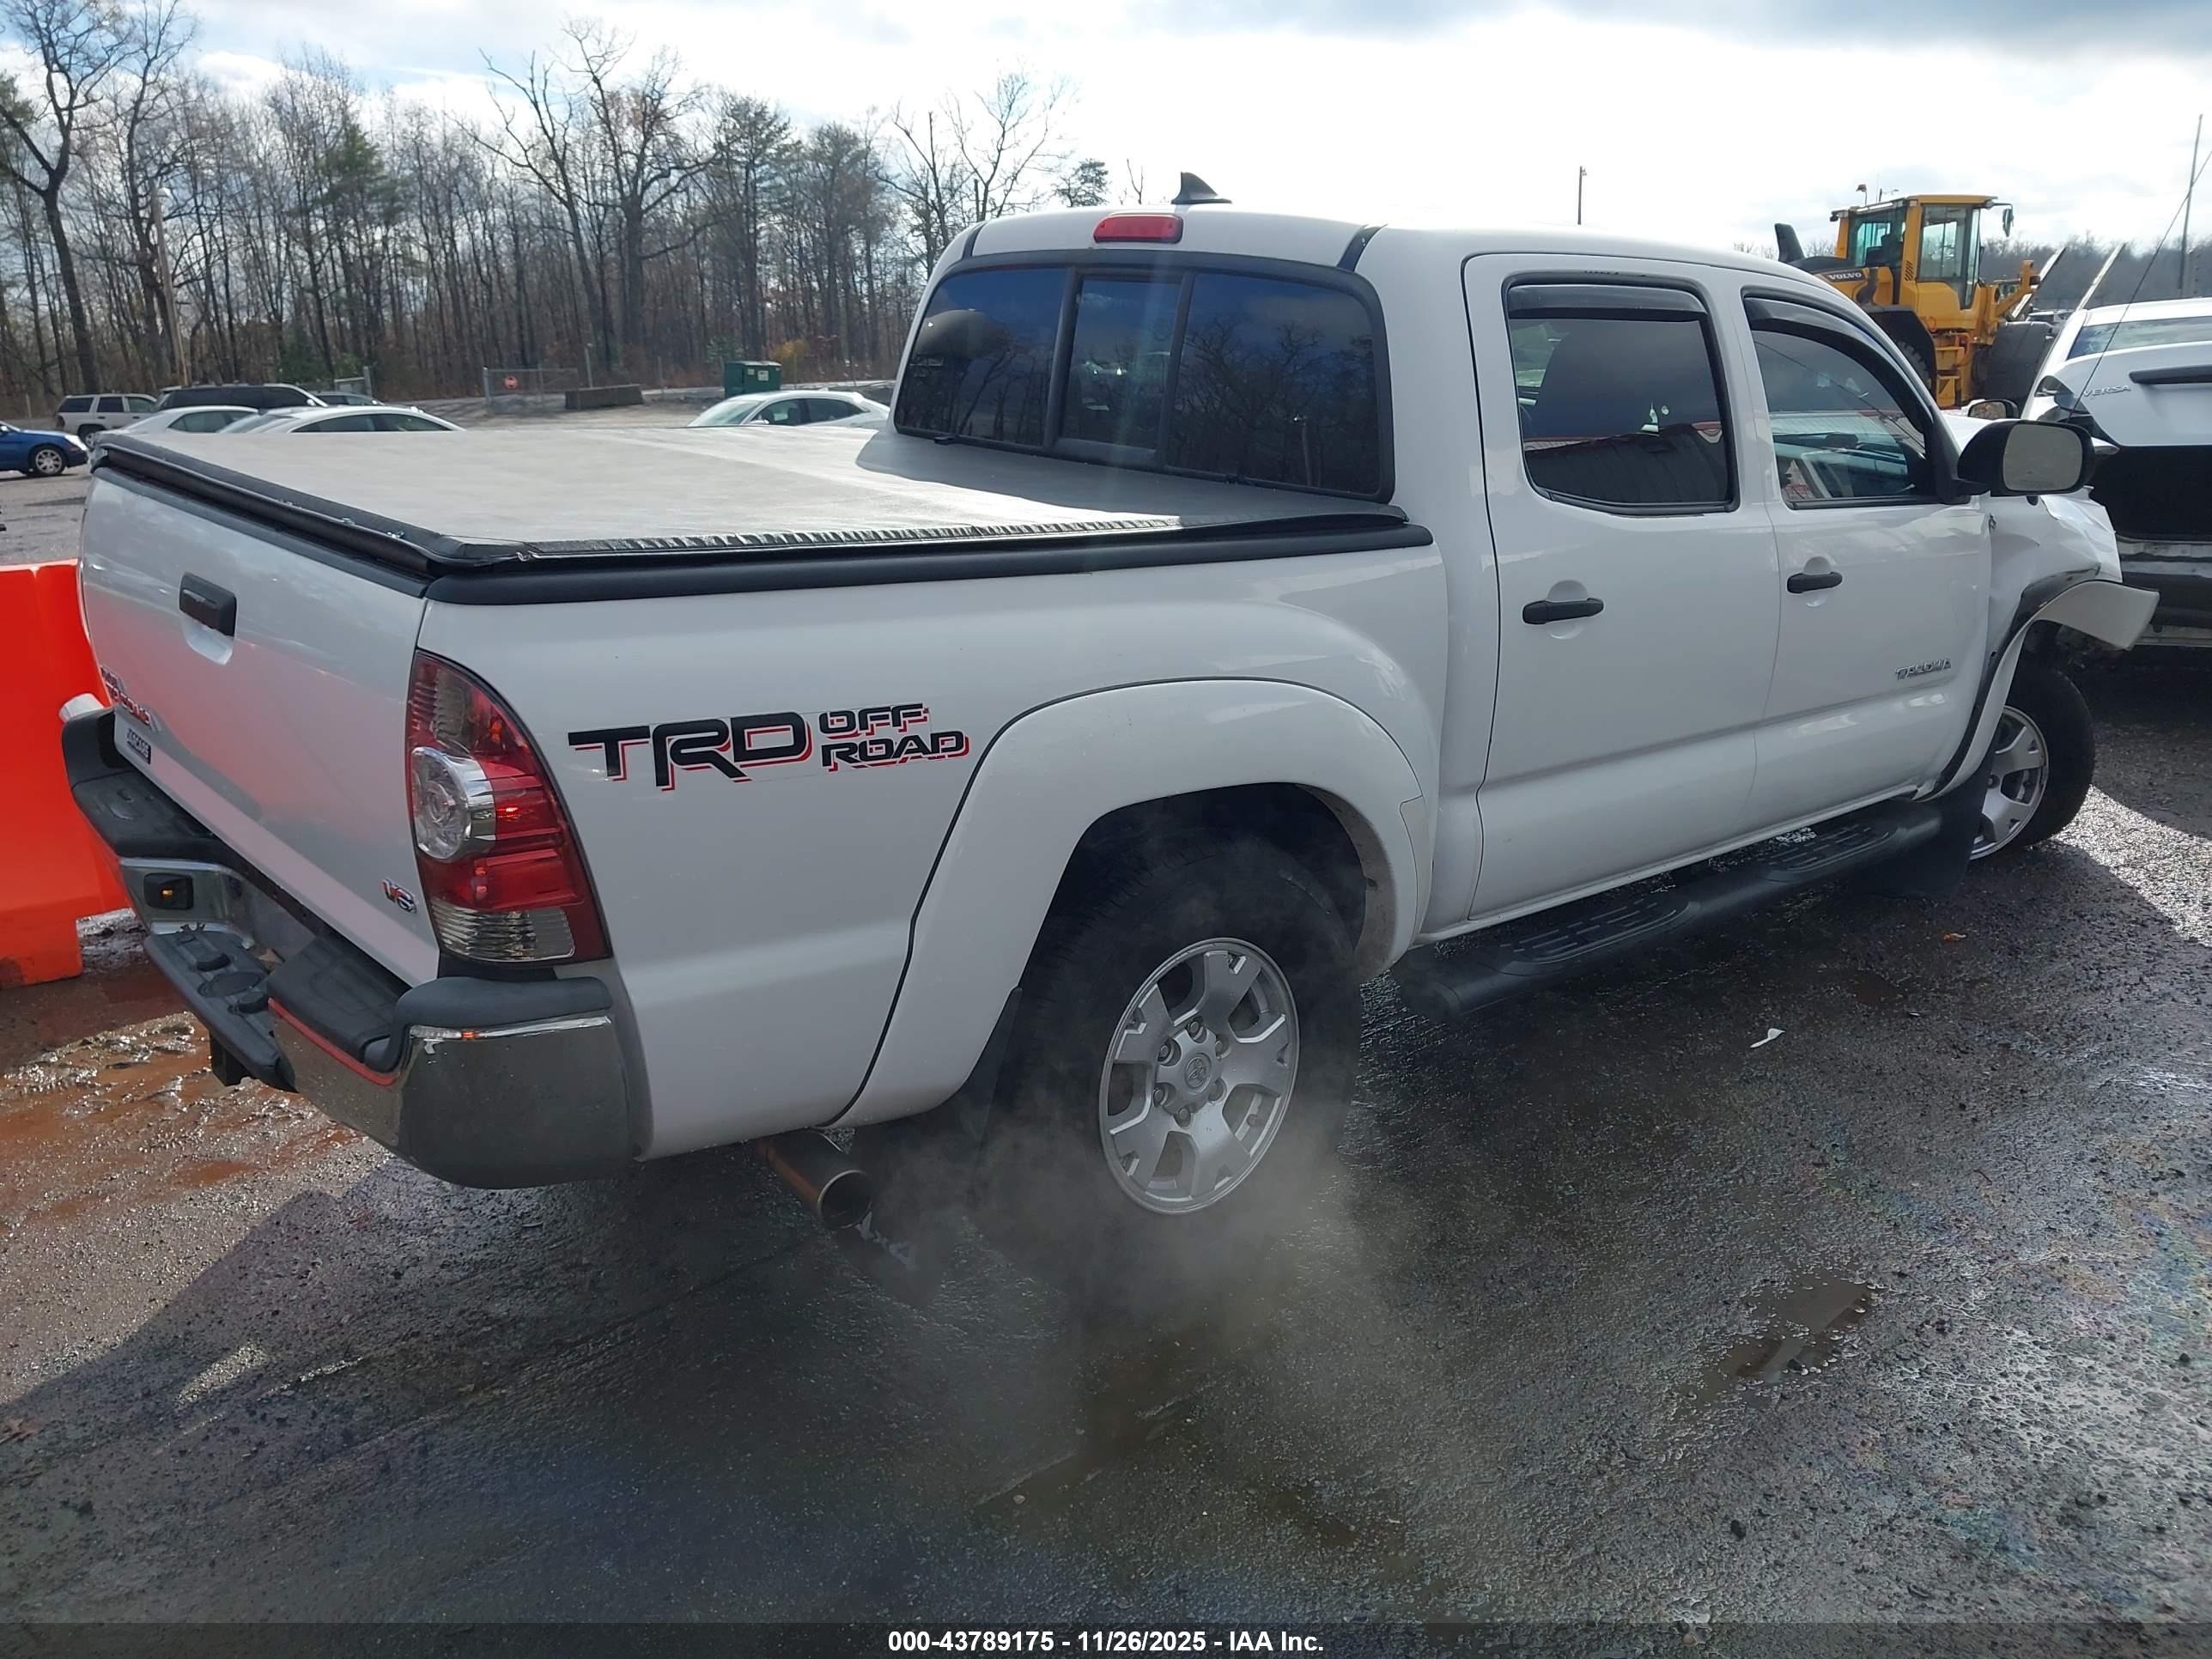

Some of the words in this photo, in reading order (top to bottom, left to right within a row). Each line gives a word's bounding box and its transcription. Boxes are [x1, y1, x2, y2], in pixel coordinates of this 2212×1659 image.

[1828, 271, 1863, 280] VOLVO
[2083, 385, 2131, 398] VERSA
[1895, 658, 1952, 680] TACOMA
[818, 702, 929, 740] OFF
[568, 711, 811, 792] TRD
[820, 730, 969, 773] ROAD
[381, 878, 415, 913] V6
